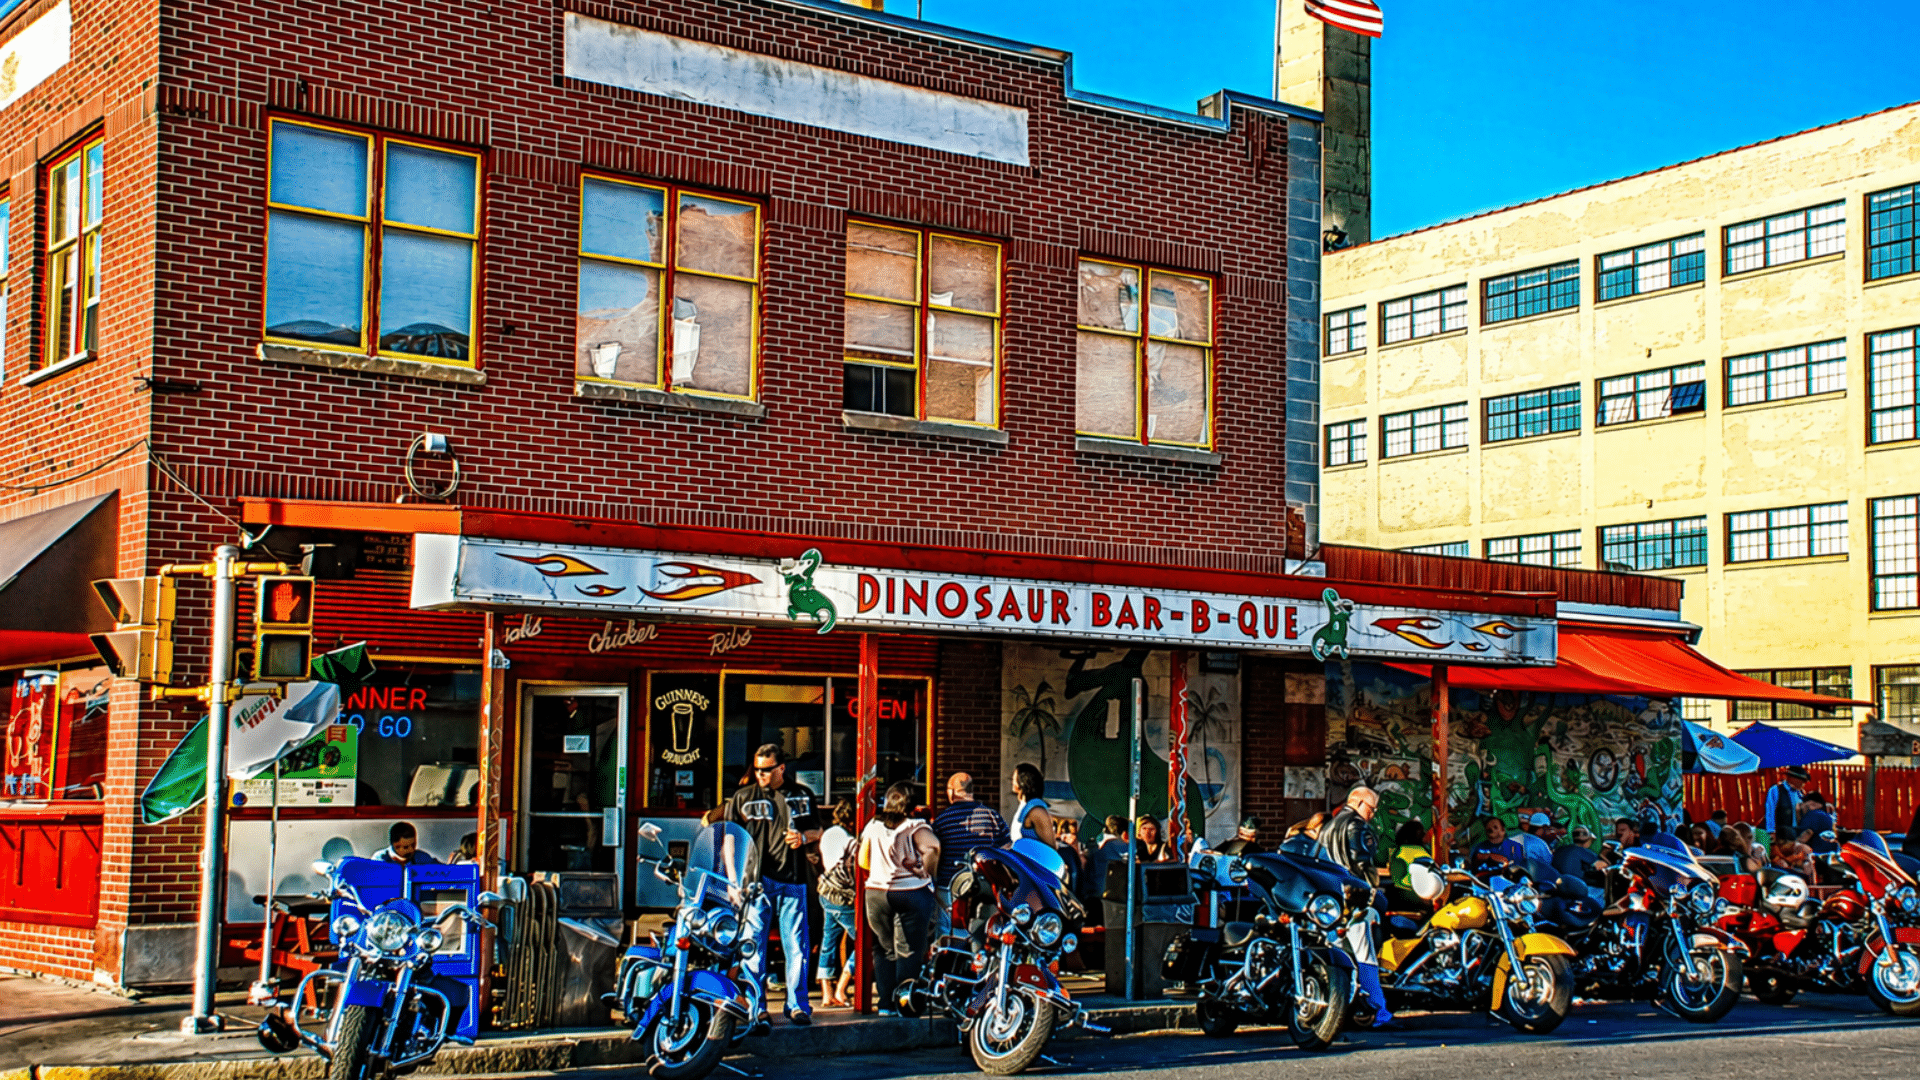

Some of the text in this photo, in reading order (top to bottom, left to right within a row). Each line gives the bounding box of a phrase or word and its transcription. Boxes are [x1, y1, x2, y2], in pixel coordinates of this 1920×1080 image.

[857, 573, 1298, 640] DINOSAUR BAR-B-QUE
[708, 626, 752, 656] Ribs
[347, 686, 427, 711] NNER
[655, 688, 710, 711] GUINNESS
[847, 698, 908, 720] OEN
[378, 715, 412, 738] GO
[661, 747, 701, 766] DRAUGHT
